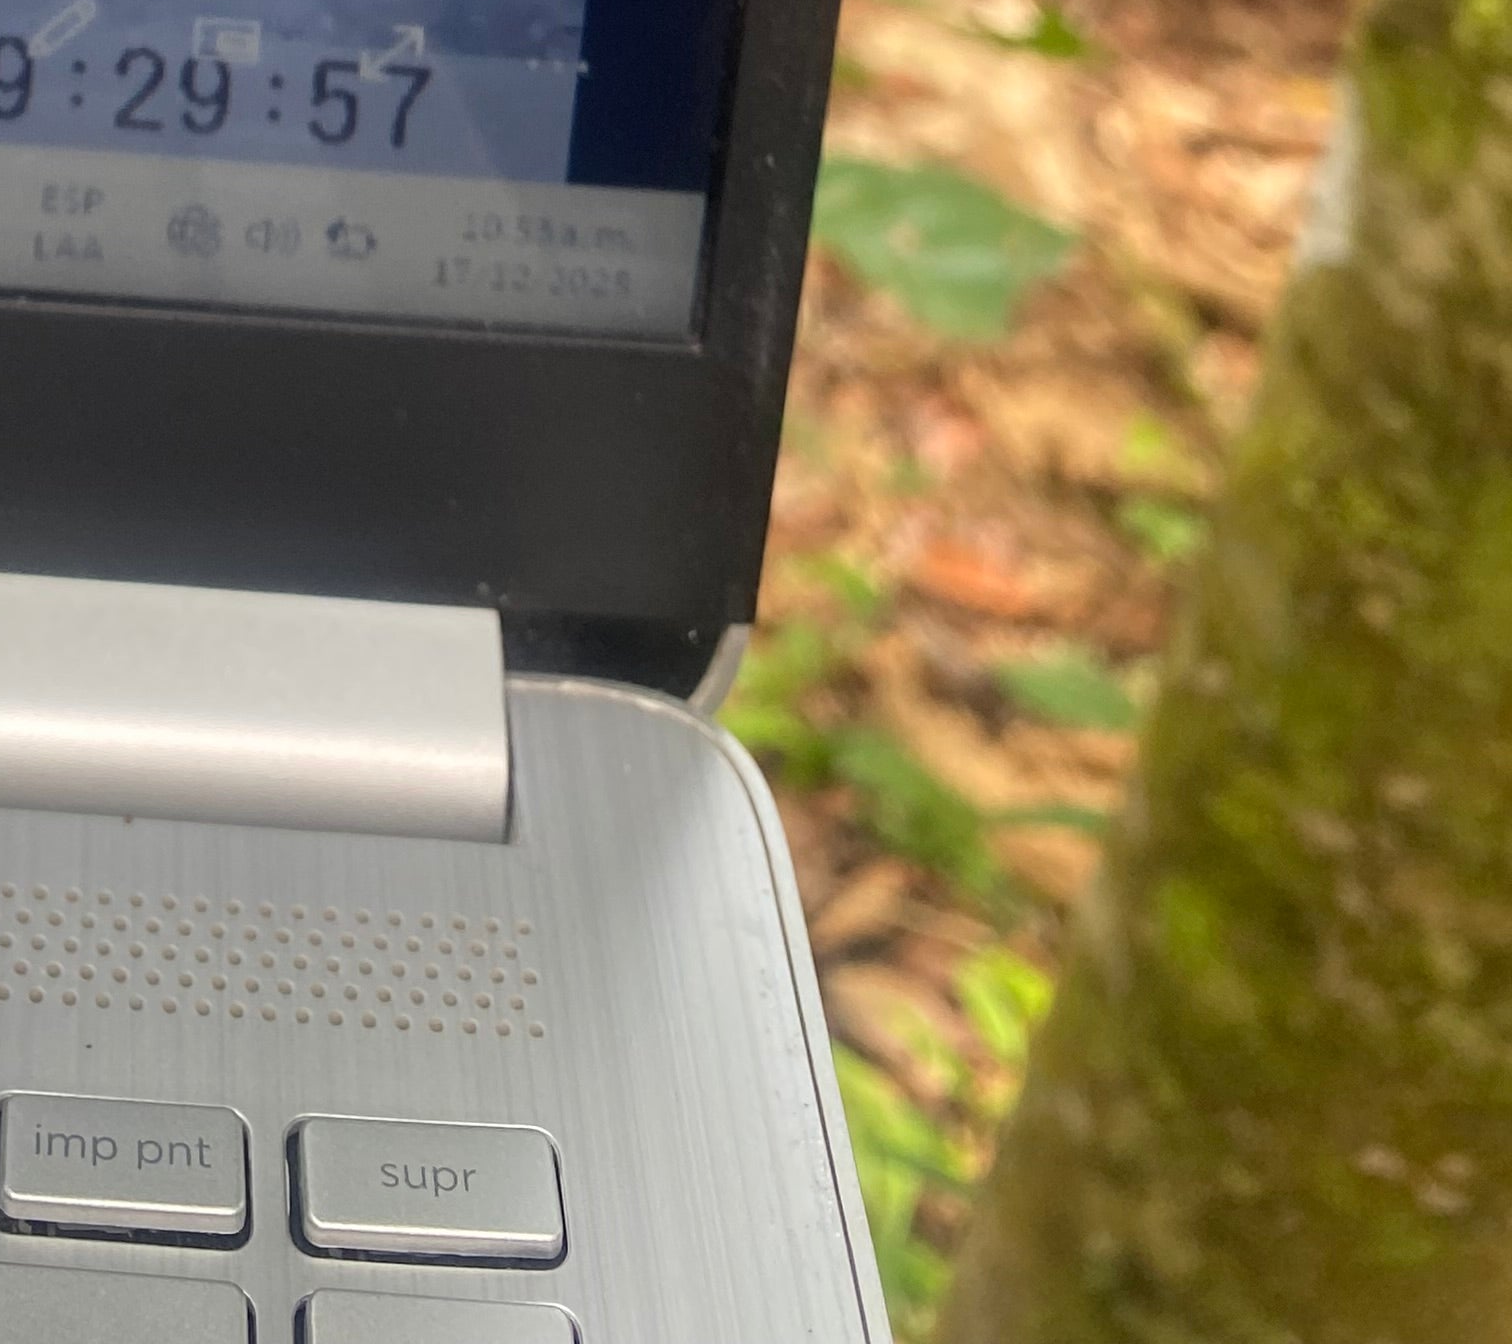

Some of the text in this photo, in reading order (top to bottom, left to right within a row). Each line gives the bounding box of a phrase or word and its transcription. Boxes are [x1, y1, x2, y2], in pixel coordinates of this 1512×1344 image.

[32, 1122, 213, 1170] imp pnt
[379, 1157, 478, 1198] supr
